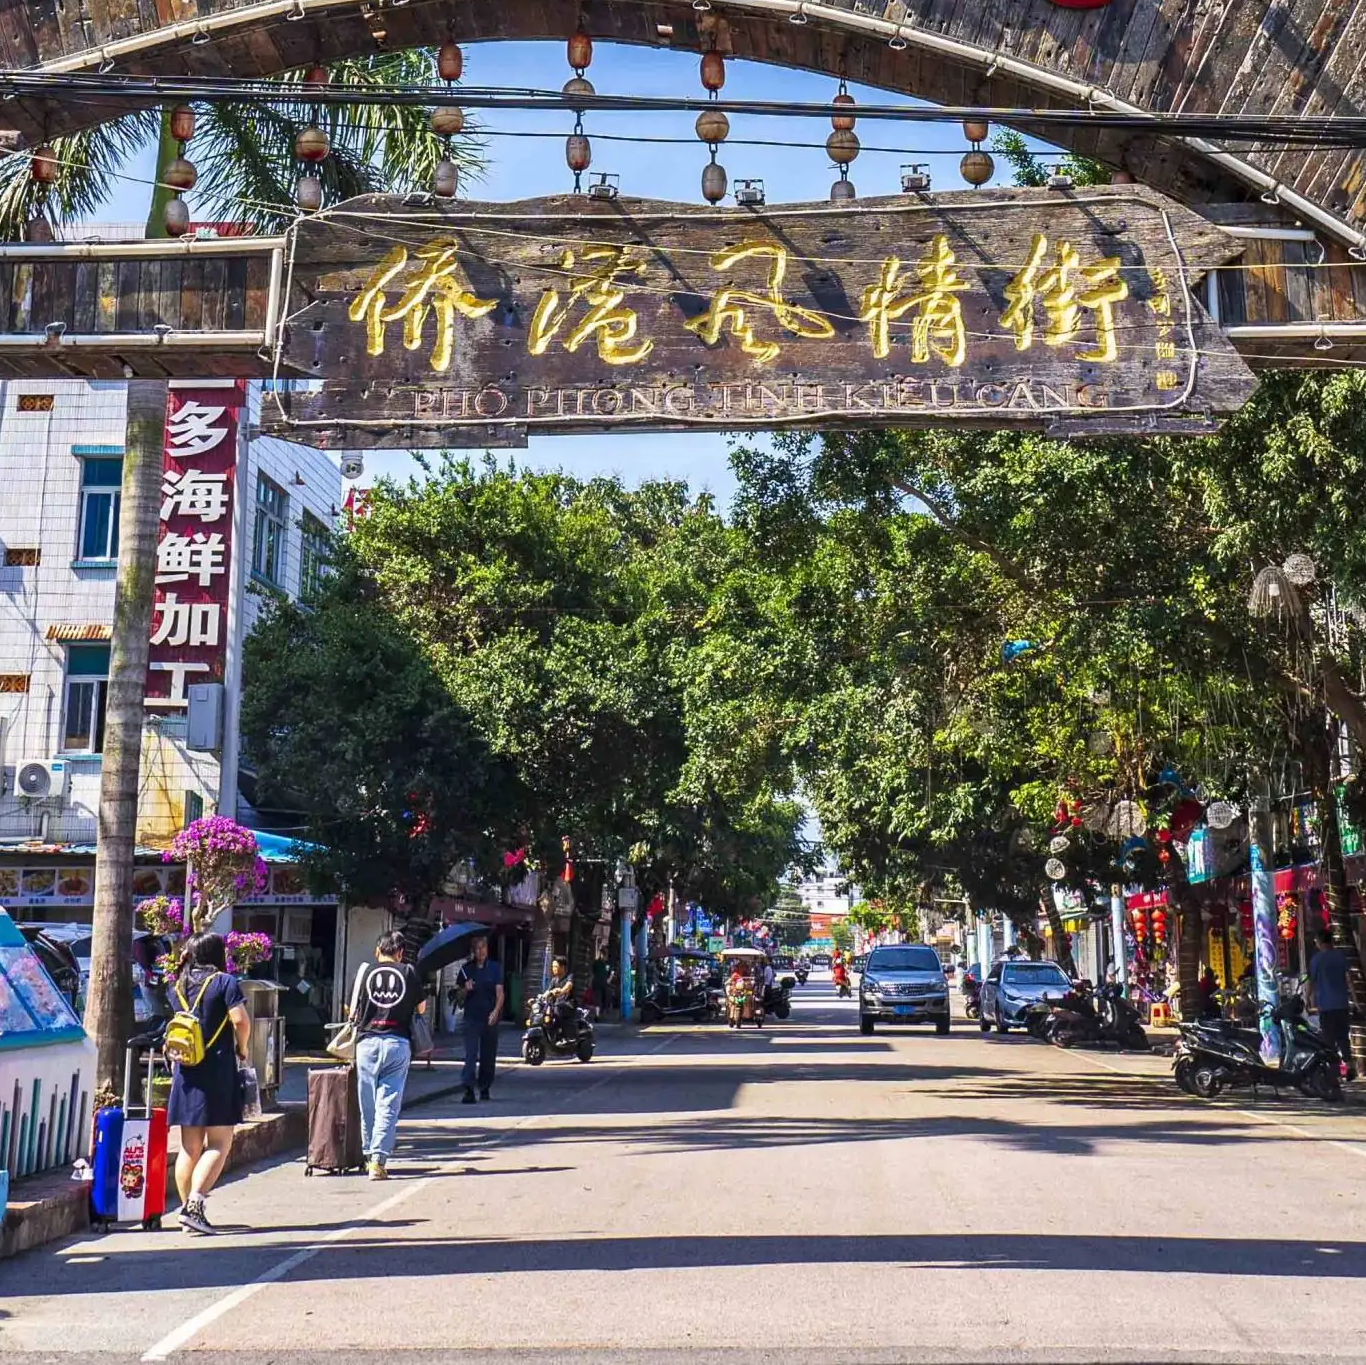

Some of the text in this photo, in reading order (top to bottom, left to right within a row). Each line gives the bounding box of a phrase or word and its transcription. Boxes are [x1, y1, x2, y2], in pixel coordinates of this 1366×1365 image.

[347, 232, 1130, 372] 侨港风情街
[523, 384, 696, 416] PHONG
[143, 379, 235, 708] 多海鲜加工
